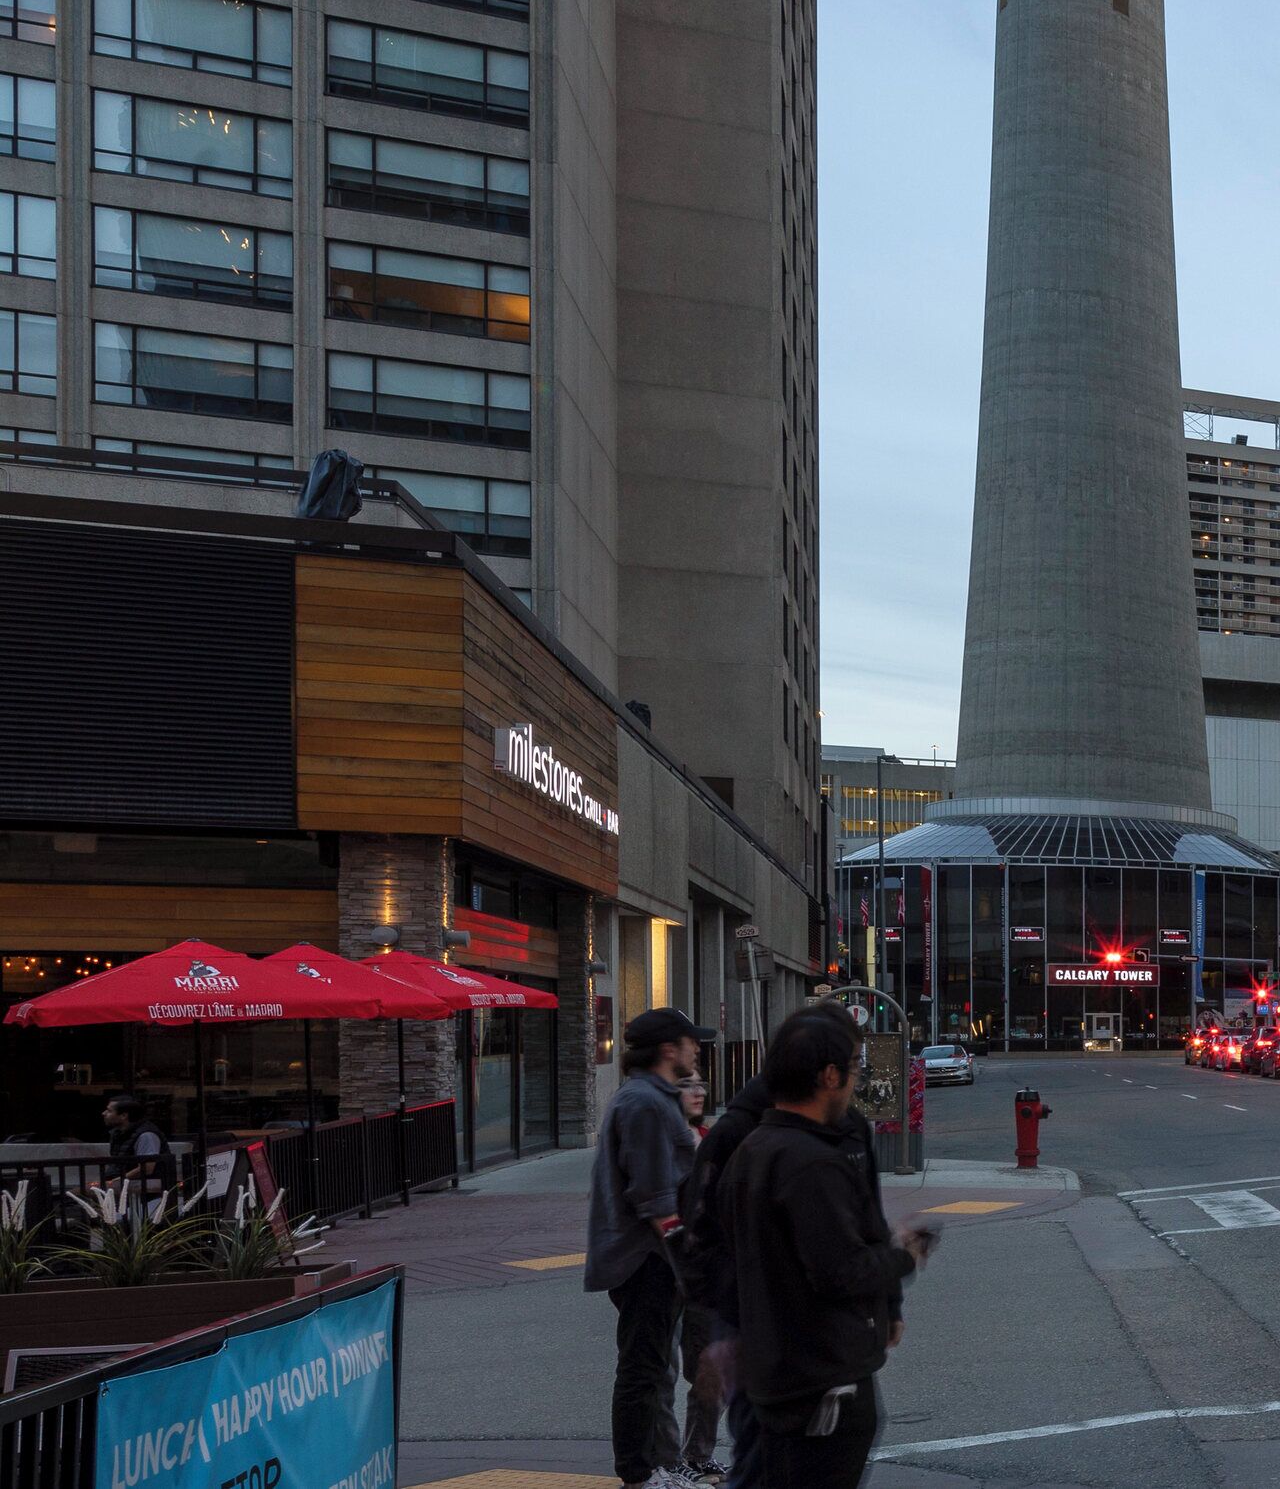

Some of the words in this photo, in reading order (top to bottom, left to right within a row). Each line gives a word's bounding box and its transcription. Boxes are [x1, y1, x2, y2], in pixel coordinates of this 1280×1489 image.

[508, 723, 583, 815] milestones
[584, 795, 602, 826] GRILL
[607, 809, 619, 836] BAR
[1055, 969, 1109, 981] CALGARY
[1114, 970, 1153, 981] TOWER
[148, 1002, 206, 1020] DÉCOUVREZ
[245, 1003, 283, 1017] MADRID
[277, 1357, 329, 1416] HOUR
